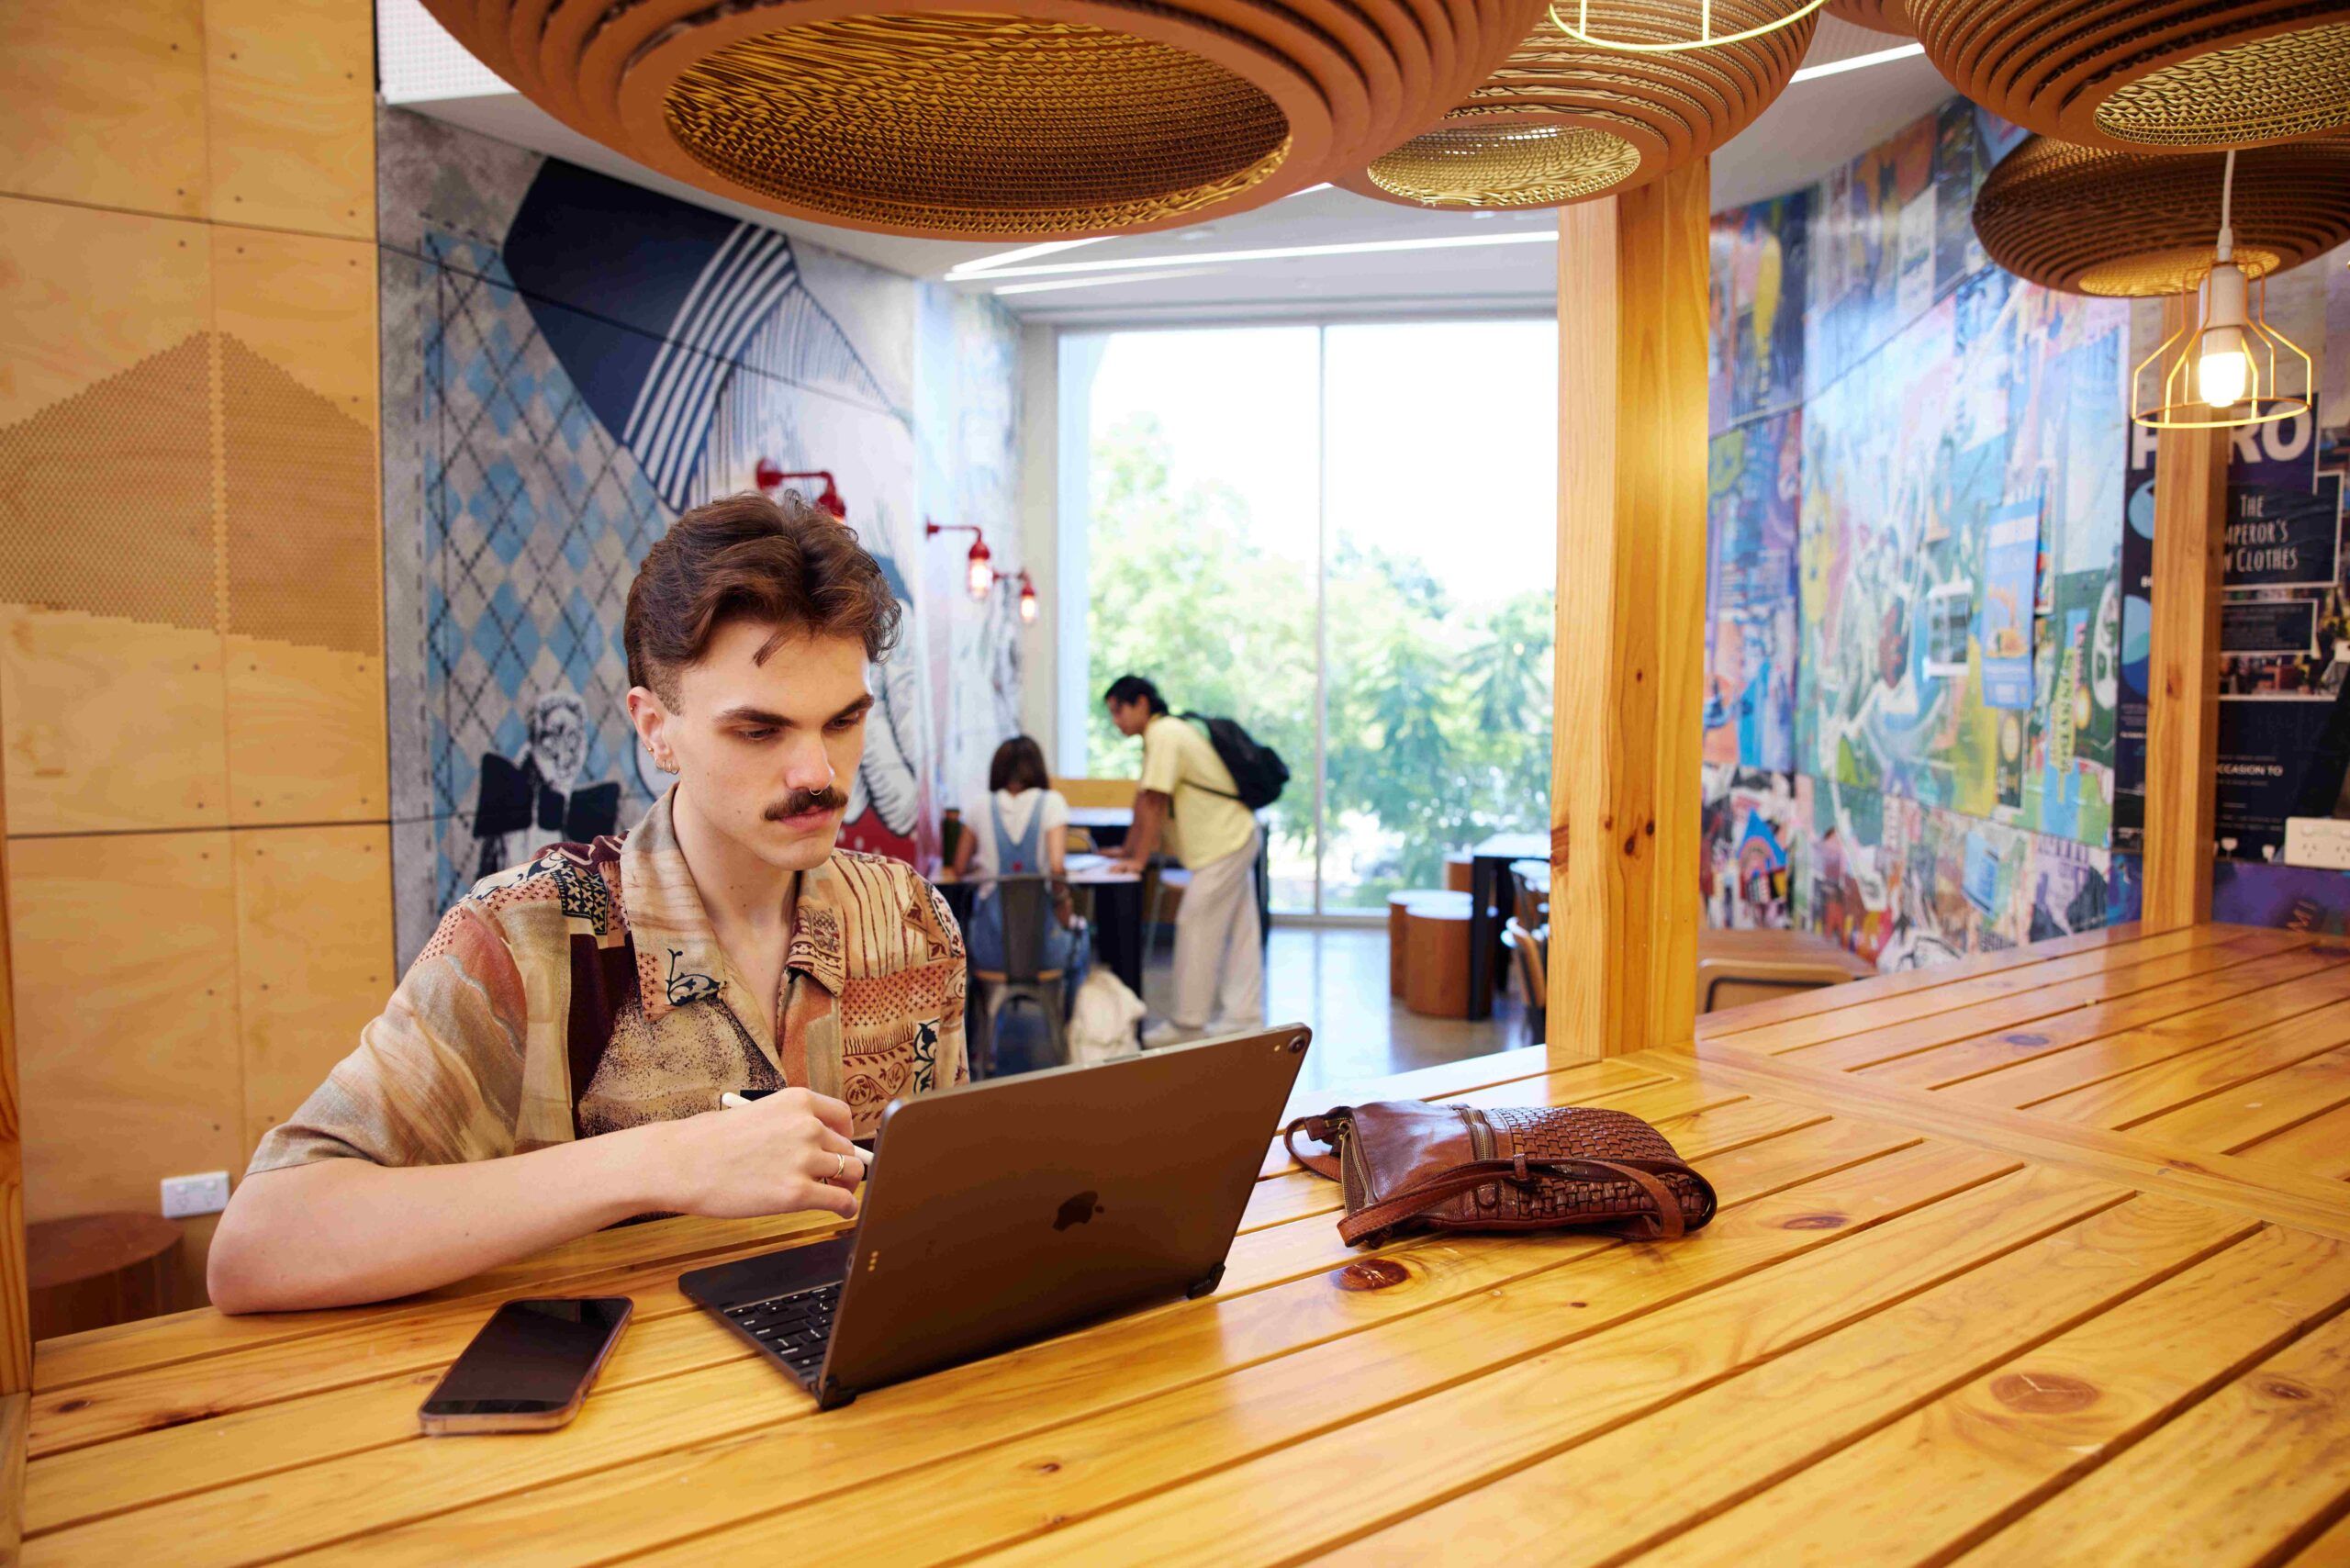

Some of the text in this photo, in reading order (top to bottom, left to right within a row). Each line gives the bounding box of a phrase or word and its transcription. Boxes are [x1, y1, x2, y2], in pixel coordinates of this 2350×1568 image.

[2240, 494, 2265, 517] THE
[2236, 547, 2299, 573] CLOTHES
[2268, 765, 2284, 777] TO
